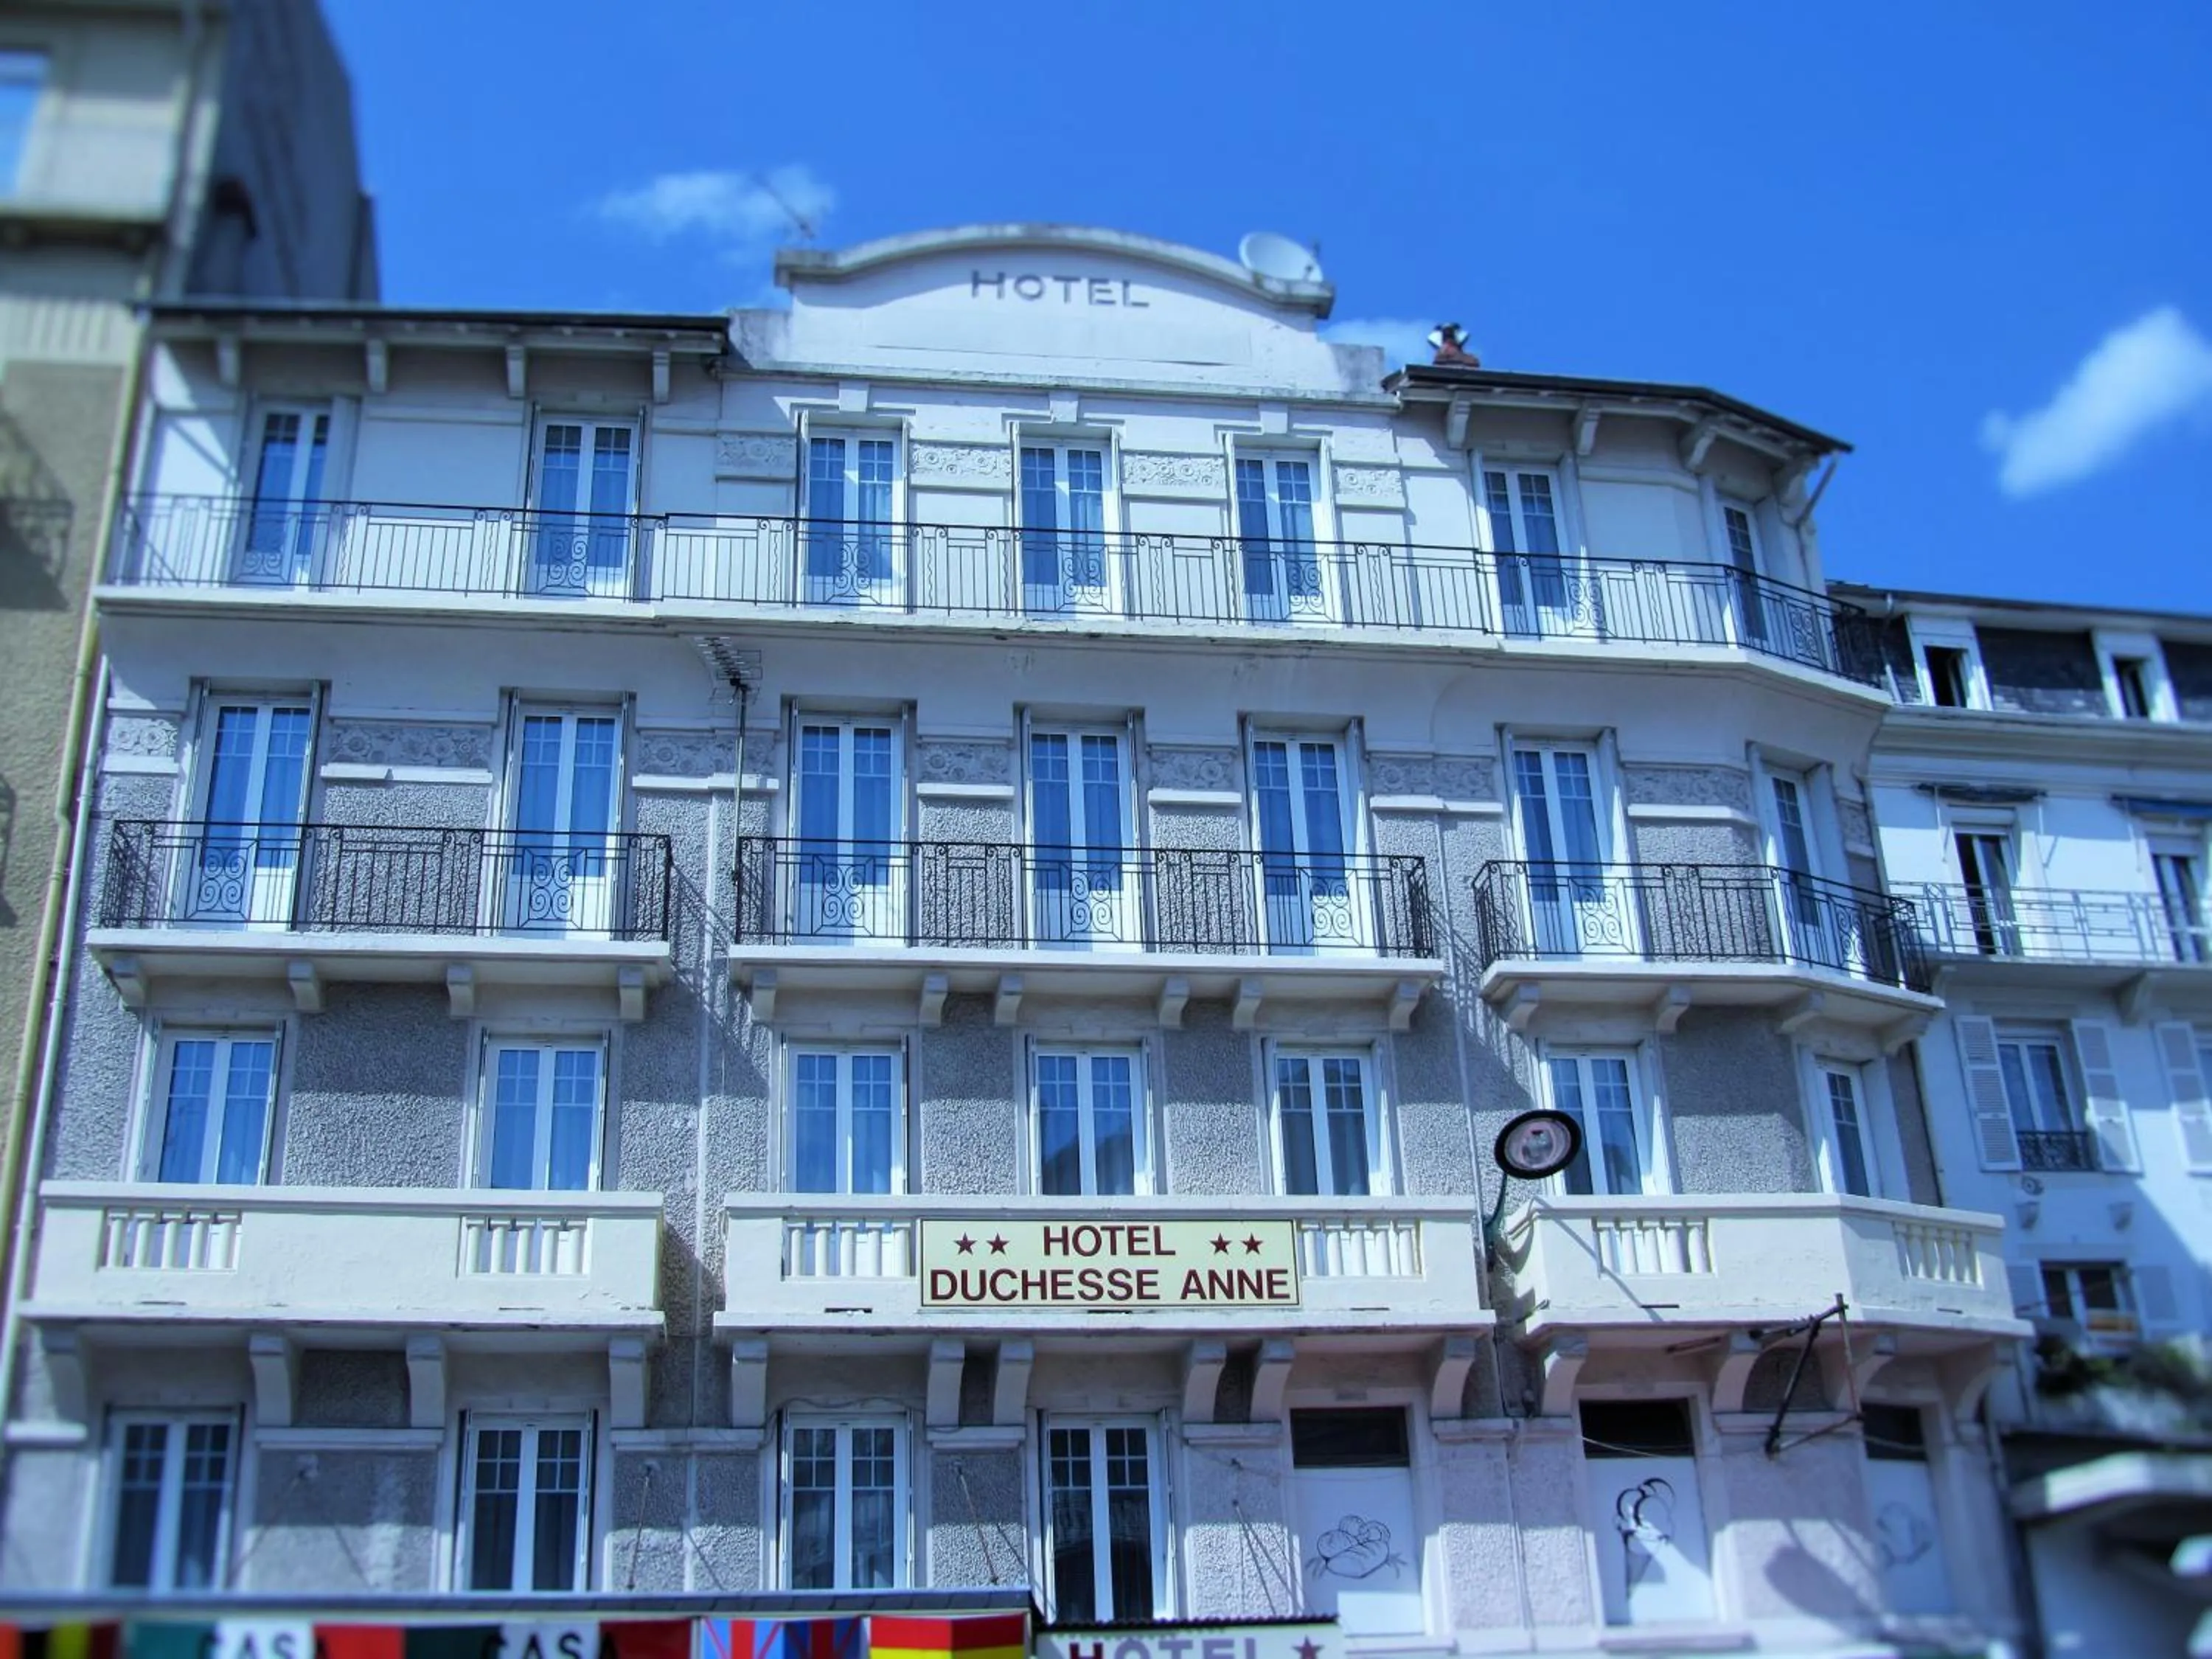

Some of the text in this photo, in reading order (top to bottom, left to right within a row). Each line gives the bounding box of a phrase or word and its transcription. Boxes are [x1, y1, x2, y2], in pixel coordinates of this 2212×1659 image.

[971, 270, 1150, 307] HOTEL
[1043, 1225, 1176, 1256] HOTEL
[930, 1267, 1291, 1301] DUCHESSE ANNE
